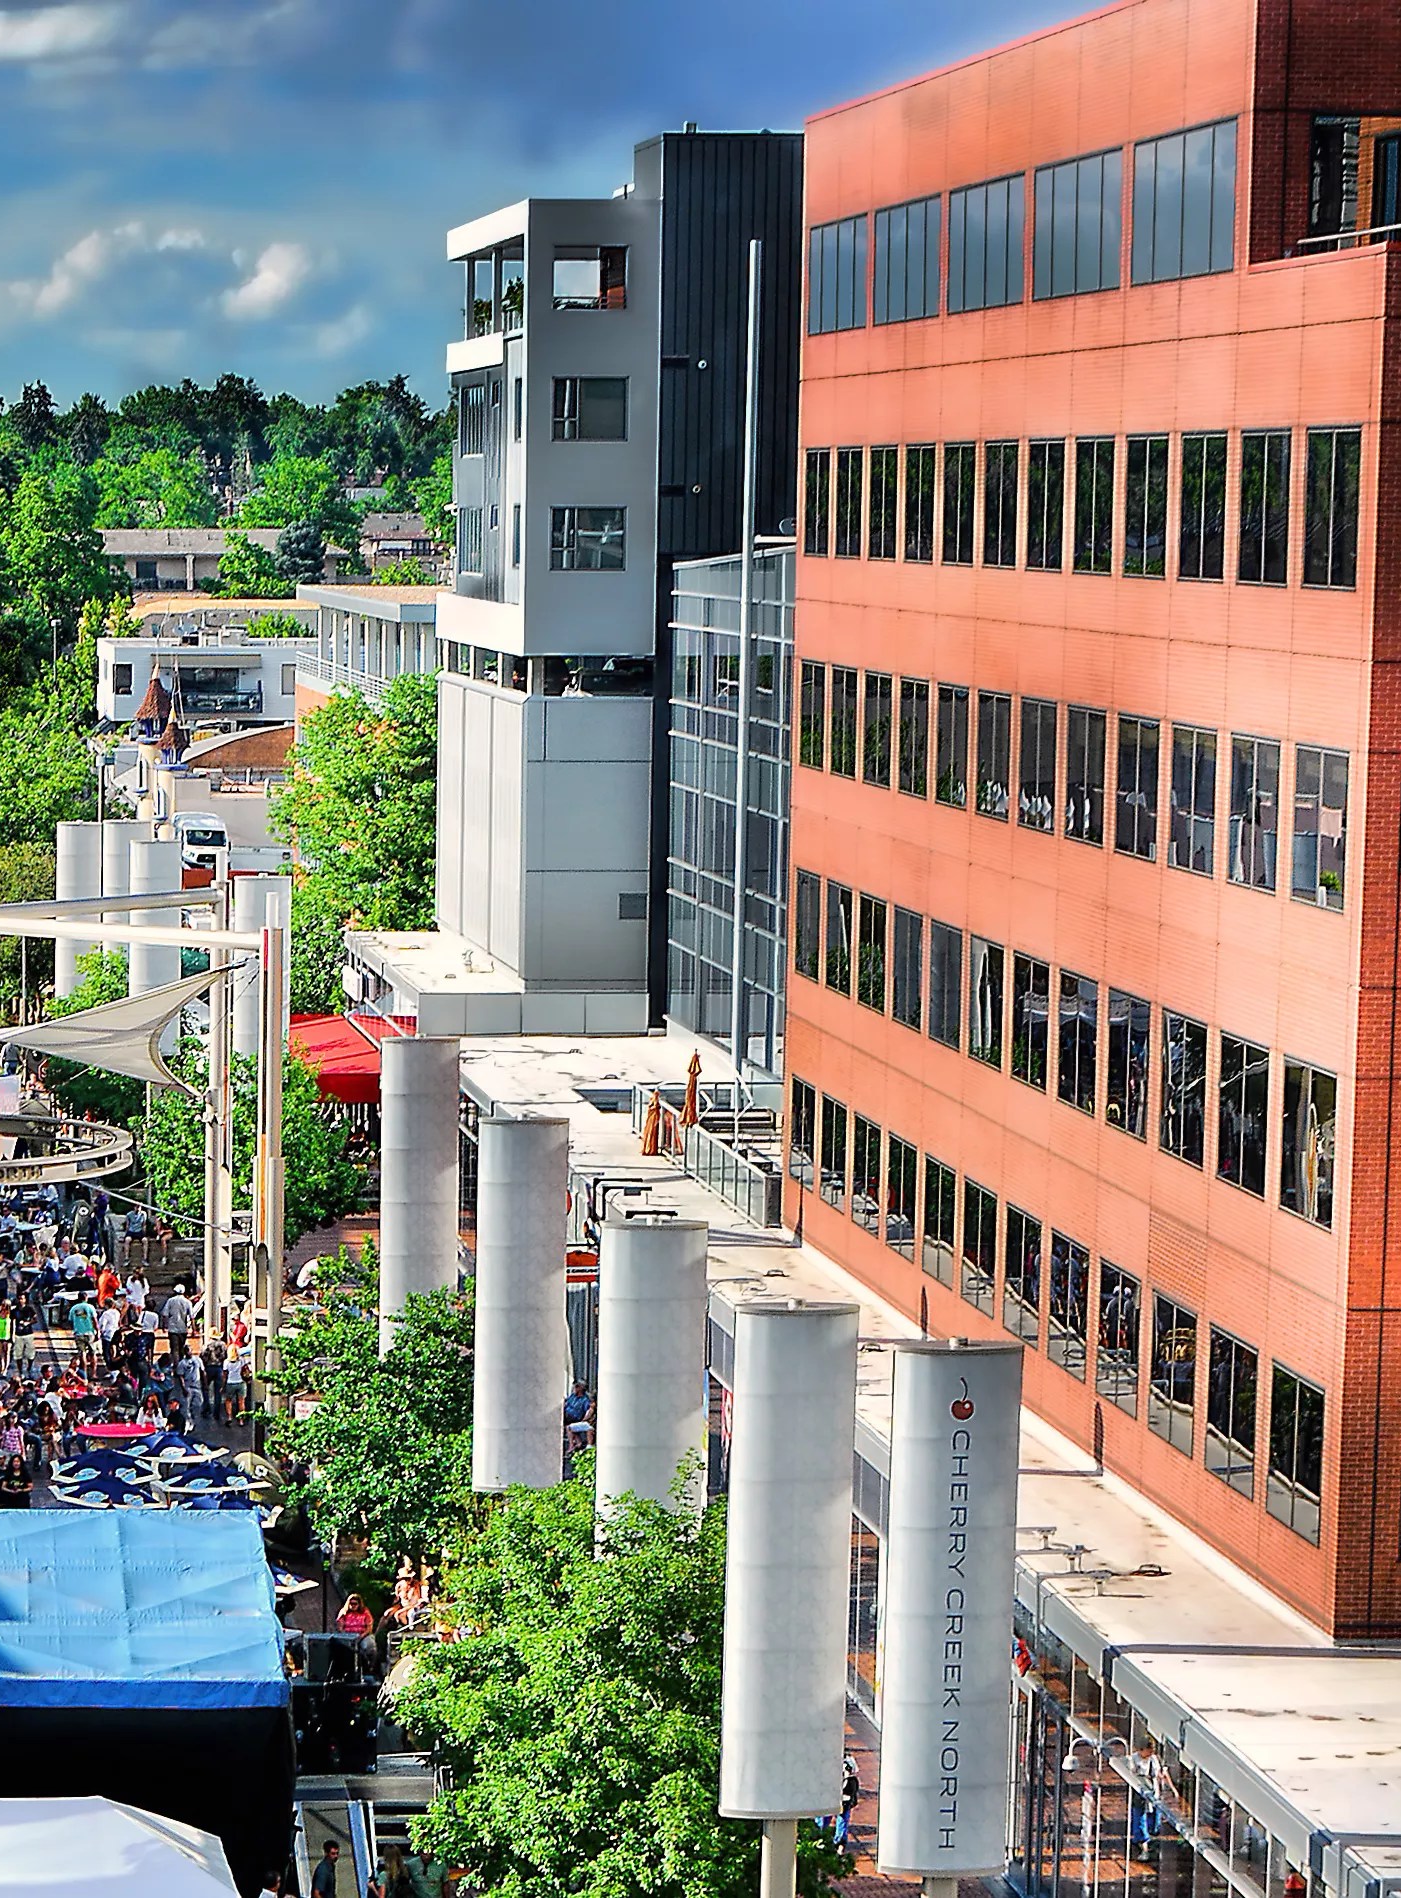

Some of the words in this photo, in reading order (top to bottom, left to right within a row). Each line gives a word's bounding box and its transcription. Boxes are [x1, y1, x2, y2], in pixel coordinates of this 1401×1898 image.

[948, 1431, 970, 1579] CHERRY
[942, 1589, 964, 1709] CREEK
[938, 1720, 960, 1850] NORTH
